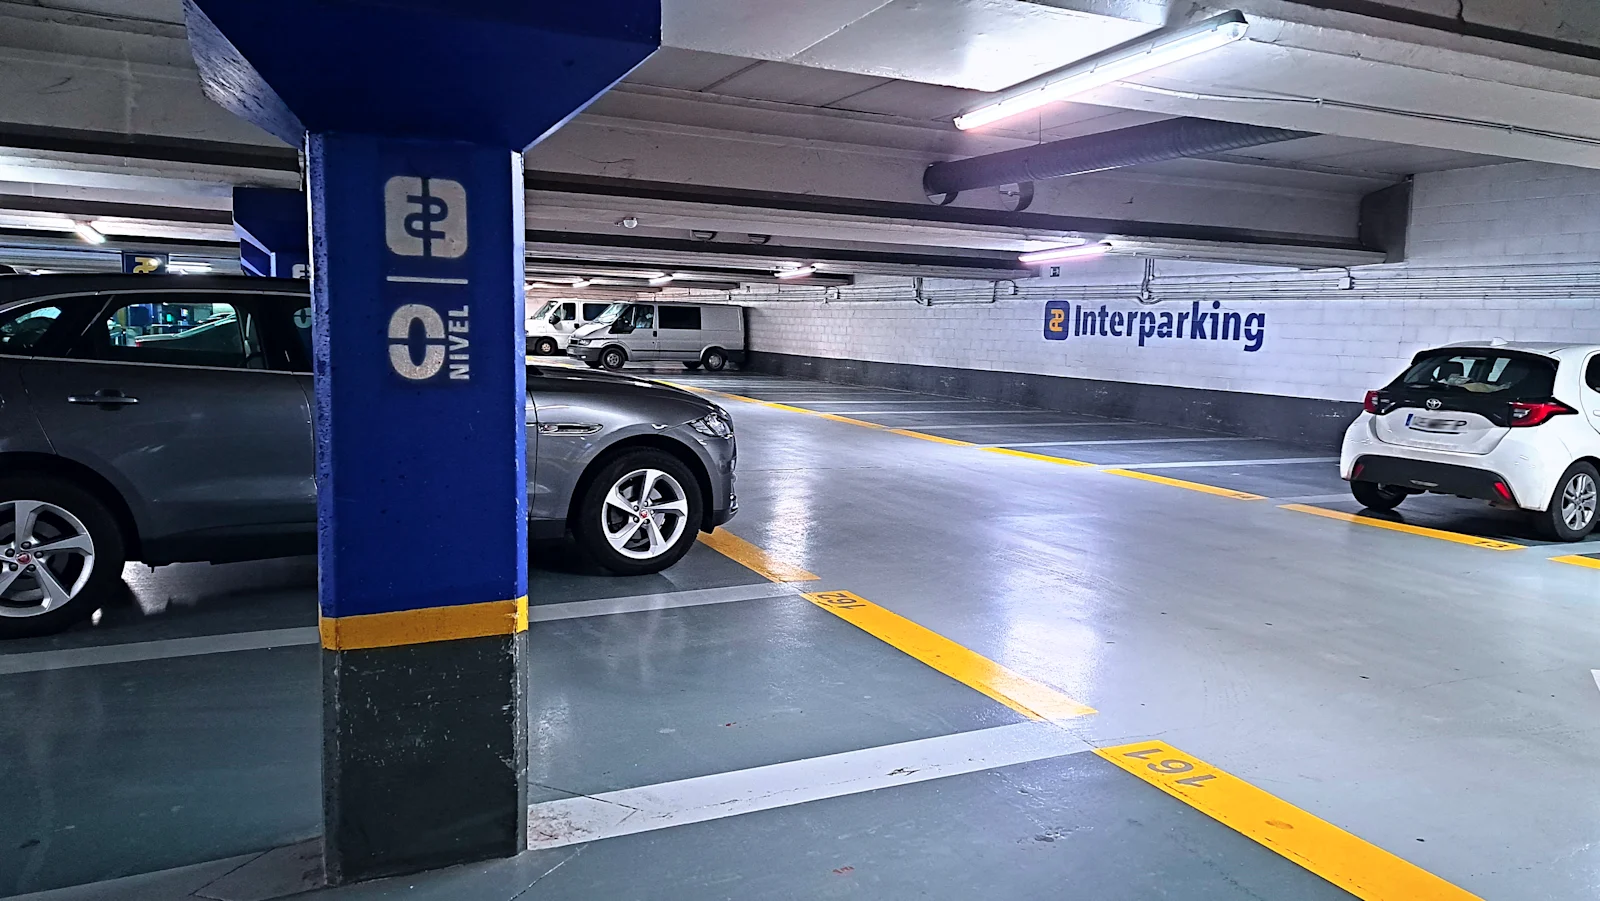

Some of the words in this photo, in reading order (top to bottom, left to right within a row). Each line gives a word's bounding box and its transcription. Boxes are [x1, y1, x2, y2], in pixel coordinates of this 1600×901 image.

[448, 305, 470, 380] NIVEL
[1074, 300, 1266, 352] Interparking
[816, 593, 867, 610] 162
[1122, 748, 1218, 788] 161
